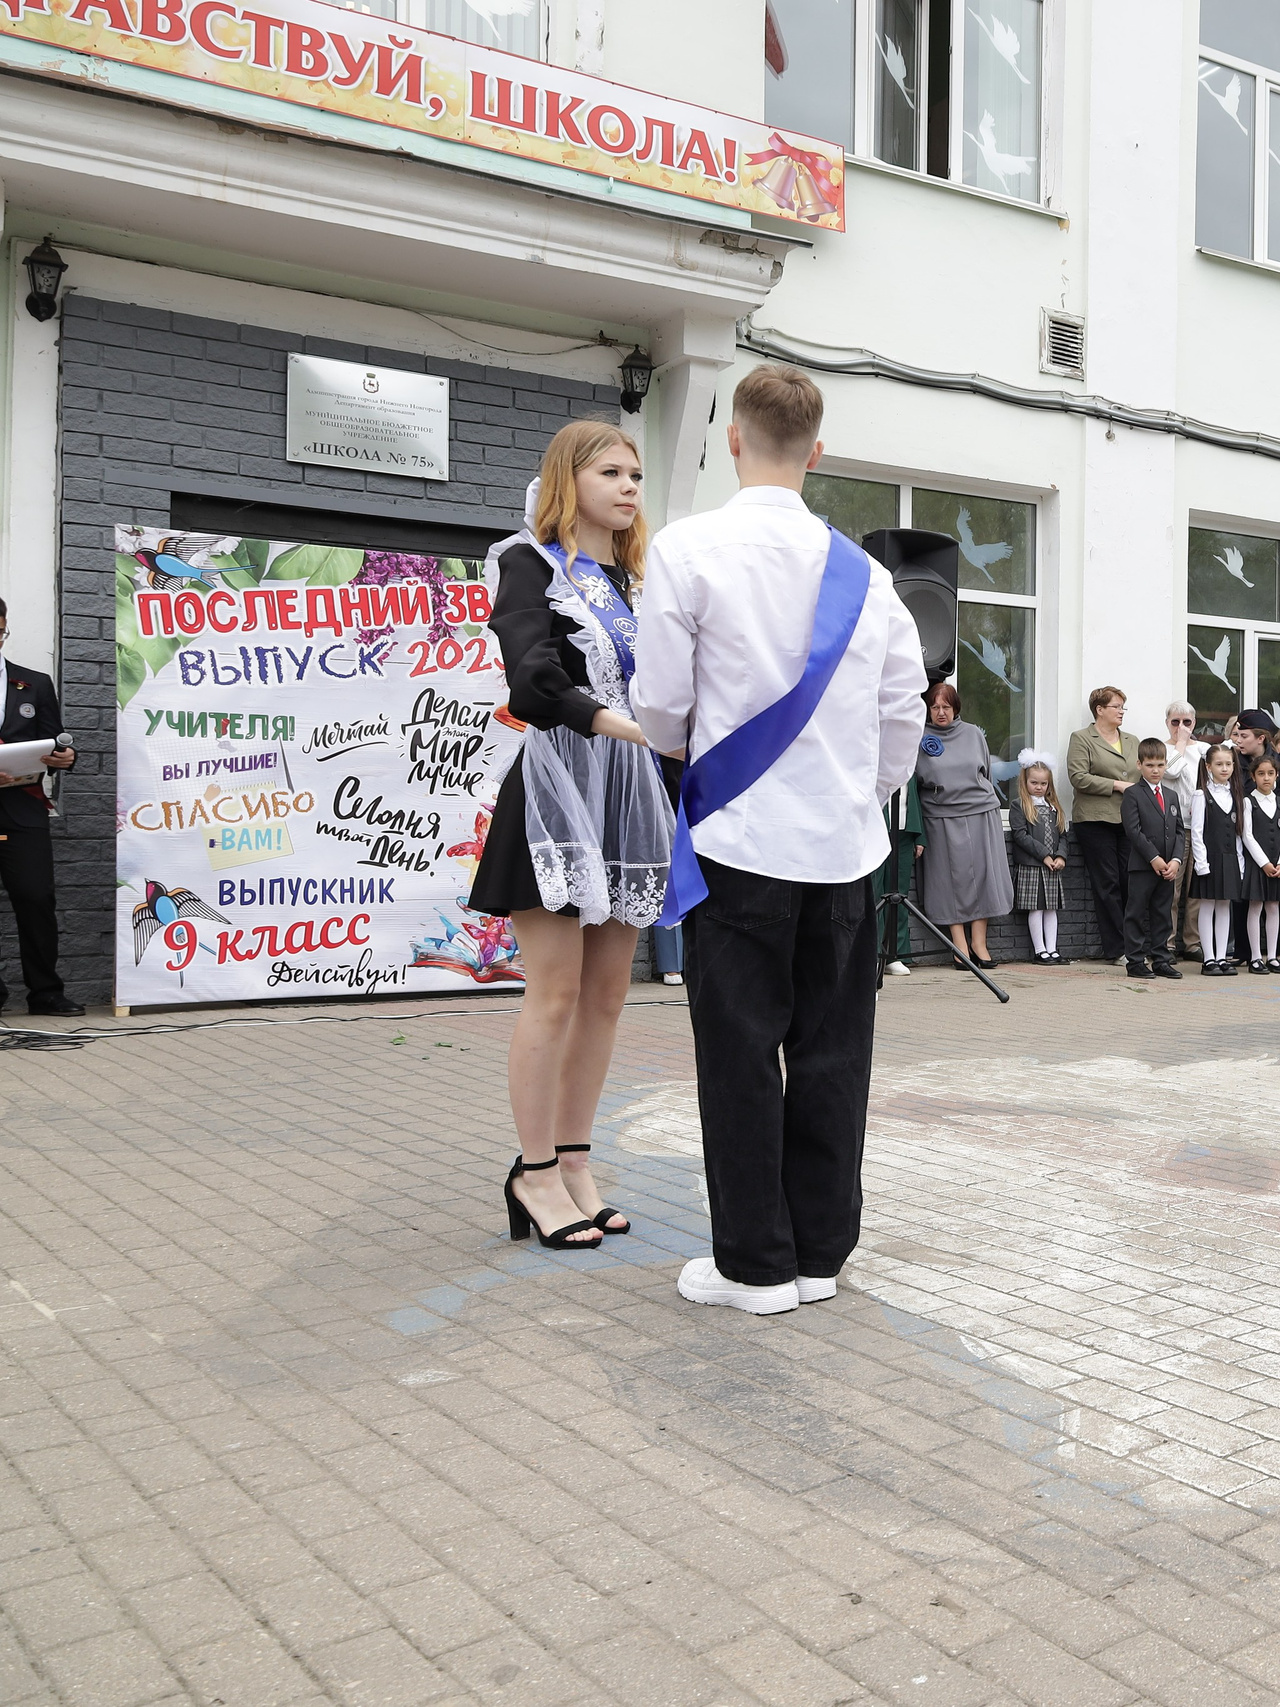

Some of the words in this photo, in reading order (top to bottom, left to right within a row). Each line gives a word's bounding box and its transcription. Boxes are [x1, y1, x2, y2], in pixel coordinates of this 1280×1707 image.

[0, 0, 444, 118] АВСТВУЙ,
[470, 70, 738, 183] ШКОЛА!
[305, 410, 380, 426] МУНИЦИПАЛЬНОЕ
[382, 420, 434, 433] БЮДЖЕТНОЕ
[320, 420, 420, 439] ОБЩЕОБРАЗОВАТЕЛЬНОЕ
[342, 430, 398, 443] УЧРЕЖДЕНИЕ
[303, 442, 382, 462] «ШКОЛА
[386, 452, 407, 465] №
[411, 455, 435, 468] 75»
[137, 580, 431, 638] ПОСЛЕДНИЙ
[445, 584, 494, 624] ЗВ
[179, 640, 388, 686] ВЫПУСК
[408, 637, 506, 678] 202
[144, 709, 295, 741] УЧИТЕЛЯ!
[401, 688, 495, 736] Делай
[302, 713, 393, 754] Мечтай
[163, 762, 190, 781] ВЫ
[196, 752, 278, 778] ЛУЧШИЕ!
[131, 791, 314, 831] СПАСИБО
[333, 776, 441, 840] Сегодня
[221, 828, 282, 851] ВАМ!
[316, 821, 374, 847] твой
[218, 877, 395, 906] ВЫПУСКНИК
[164, 920, 198, 971] 9
[216, 913, 371, 965] класс
[267, 948, 407, 994] Действуй!
